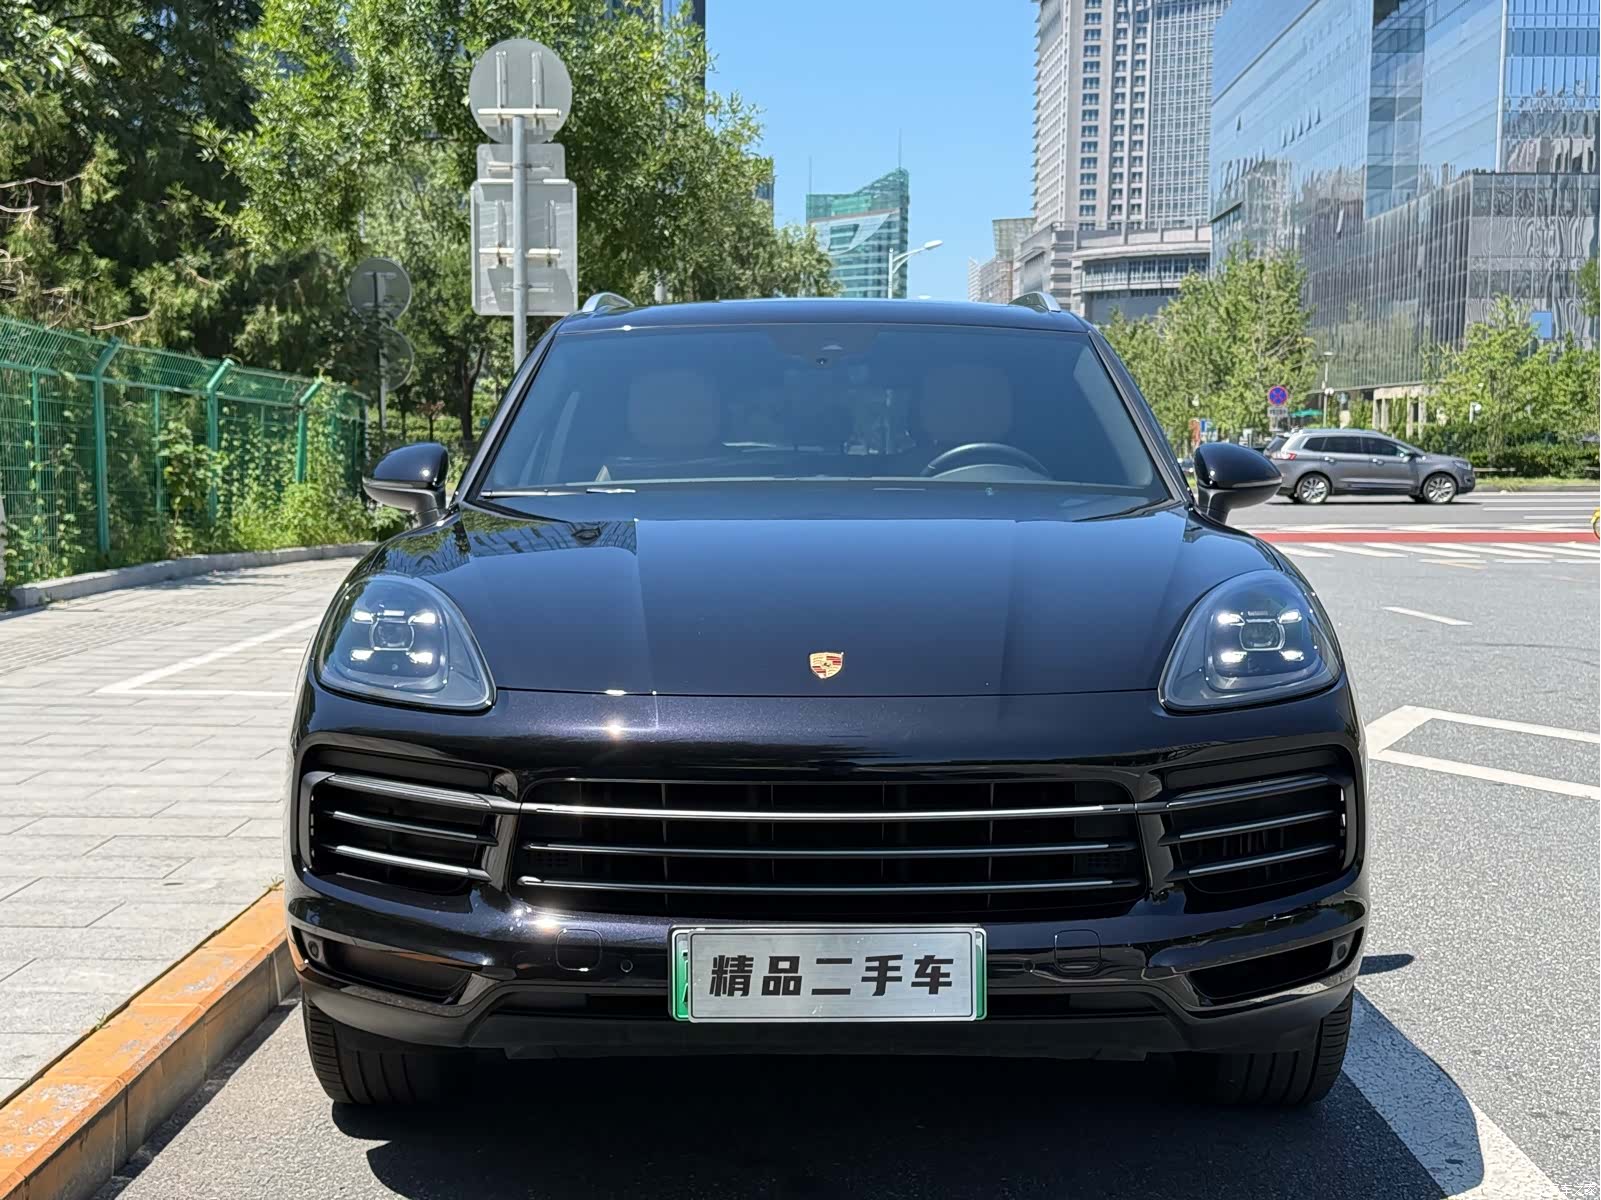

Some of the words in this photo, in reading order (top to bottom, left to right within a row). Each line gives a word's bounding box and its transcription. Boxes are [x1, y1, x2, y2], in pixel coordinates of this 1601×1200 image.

[709, 954, 954, 997] 精品二手车
